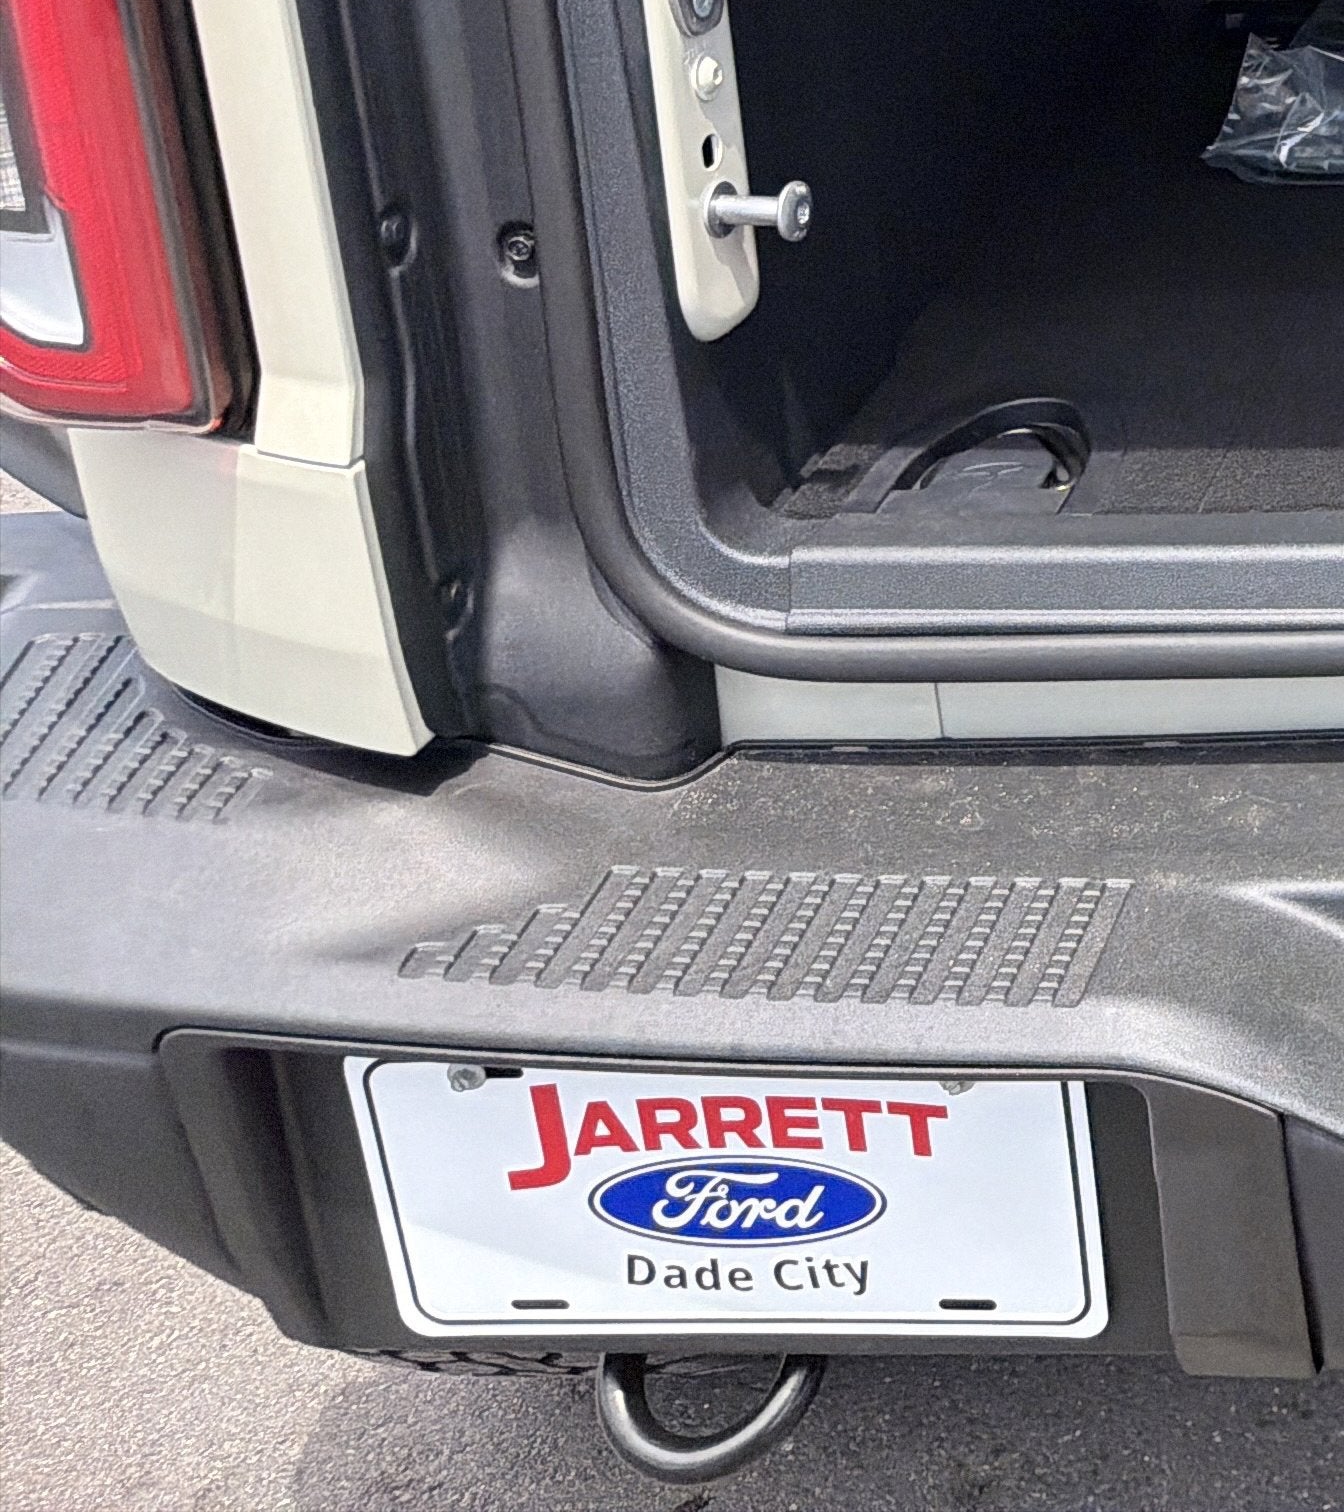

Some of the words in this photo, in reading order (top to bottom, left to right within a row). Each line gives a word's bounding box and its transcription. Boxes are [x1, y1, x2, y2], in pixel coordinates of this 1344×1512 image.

[507, 1083, 949, 1191] JARRETT
[651, 1168, 826, 1230] Ford
[626, 1254, 754, 1292] Dade
[773, 1256, 869, 1296] City
